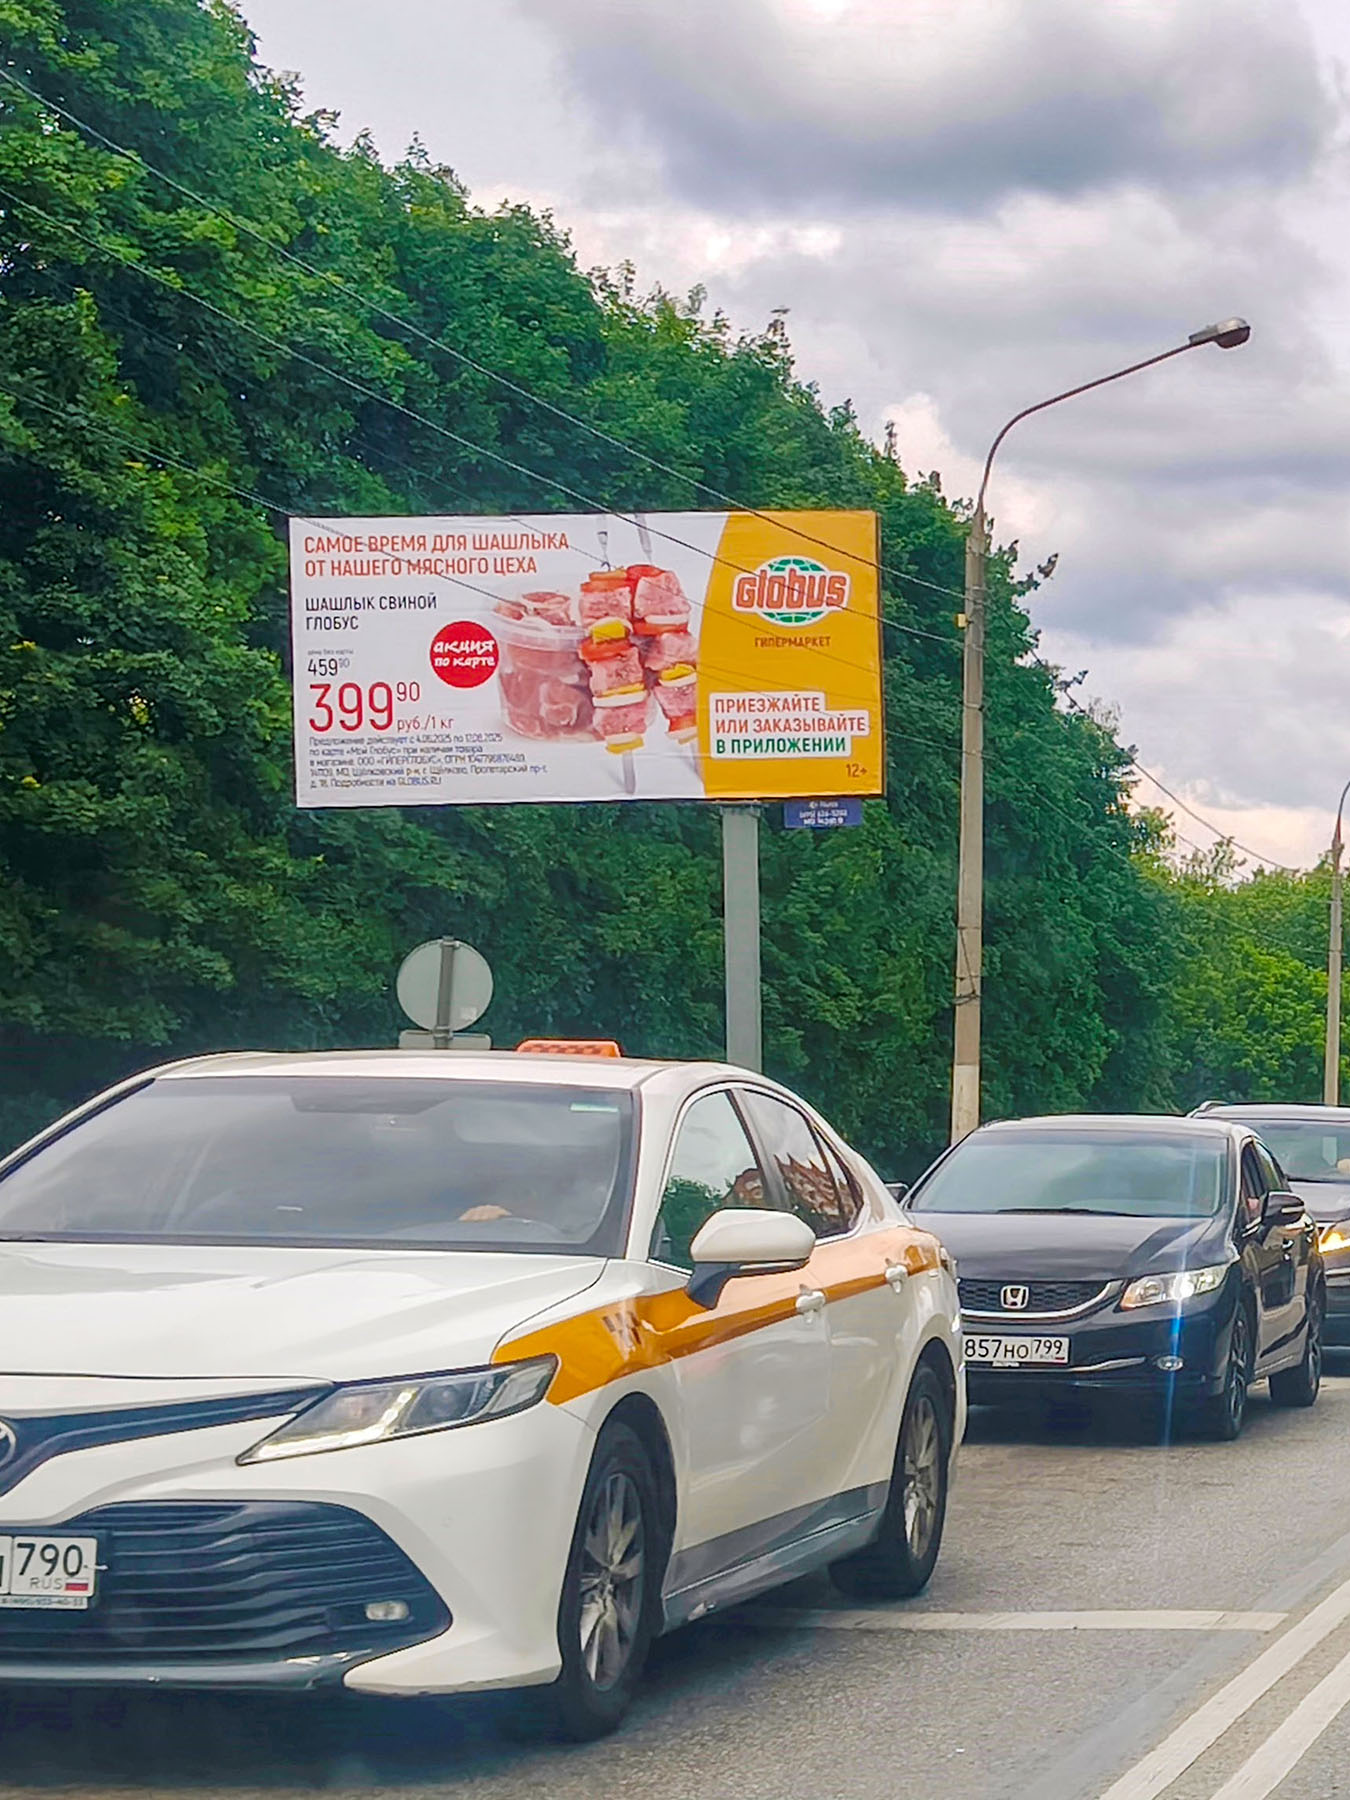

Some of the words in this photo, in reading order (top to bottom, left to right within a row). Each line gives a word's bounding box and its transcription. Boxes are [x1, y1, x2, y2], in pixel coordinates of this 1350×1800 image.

[304, 536, 363, 553] САМОЕ
[368, 535, 426, 552] ВРЕМЯ
[431, 534, 467, 553] ДЛЯ
[473, 532, 569, 550] ШАШЛЫКА
[305, 559, 326, 576] ОТ
[331, 558, 402, 576] НАШЕГО
[407, 558, 489, 575] МЯСНОГО
[494, 556, 537, 575] ЦЕХА
[305, 597, 375, 611] ШАШЛЫК
[379, 592, 437, 610] СВИНОЙ
[306, 616, 359, 630] ГЛОБУС
[433, 640, 495, 655] акция
[755, 636, 831, 648] ГИПЕРМАРКЕТ
[434, 657, 450, 667] по
[453, 656, 496, 669] карте
[715, 694, 820, 713] ПРИЕЗЖАЙТЕ
[440, 718, 455, 729] кг
[716, 719, 748, 734] ИЛИ
[753, 713, 866, 734] ЗАКАЗЫВАЙТЕ
[717, 739, 726, 754] В
[731, 737, 846, 754] ПРИЛОЖЕНИИ
[846, 763, 868, 778] 12+
[964, 1338, 1030, 1359] 857НО
[16, 1542, 84, 1577] 790
[30, 1577, 63, 1591] RUS
